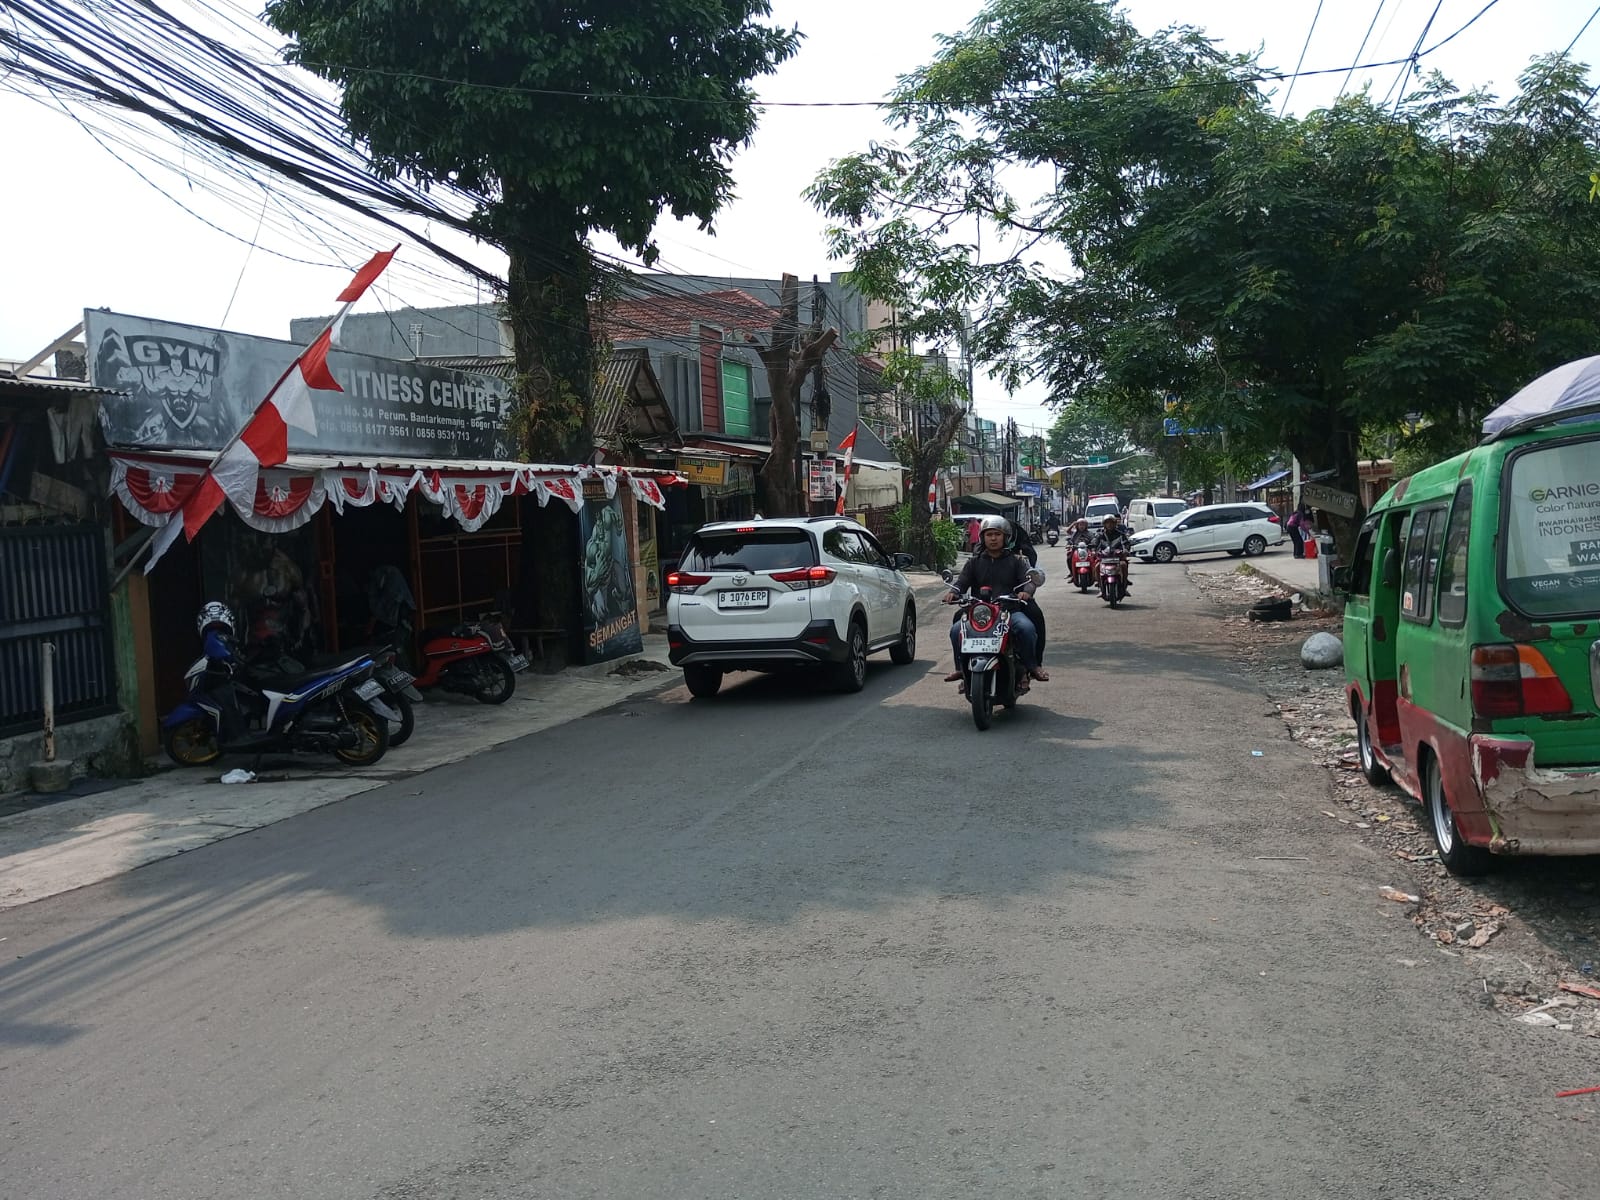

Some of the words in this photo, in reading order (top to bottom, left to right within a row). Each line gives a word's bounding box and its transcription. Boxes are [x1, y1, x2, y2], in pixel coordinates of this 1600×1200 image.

[337, 367, 425, 405] FITNESS
[429, 379, 497, 414] CENTRE
[378, 408, 409, 422] Perum.
[410, 412, 465, 429] Bantarkemang
[470, 417, 491, 431] Bogor
[365, 423, 387, 436] 6177
[389, 425, 410, 437] 9561
[416, 427, 436, 439] 0856
[1536, 504, 1565, 514] Color
[720, 593, 726, 602] B
[730, 592, 750, 602] 1076
[751, 591, 767, 601] ERP
[589, 610, 637, 648] SEMANGAT
